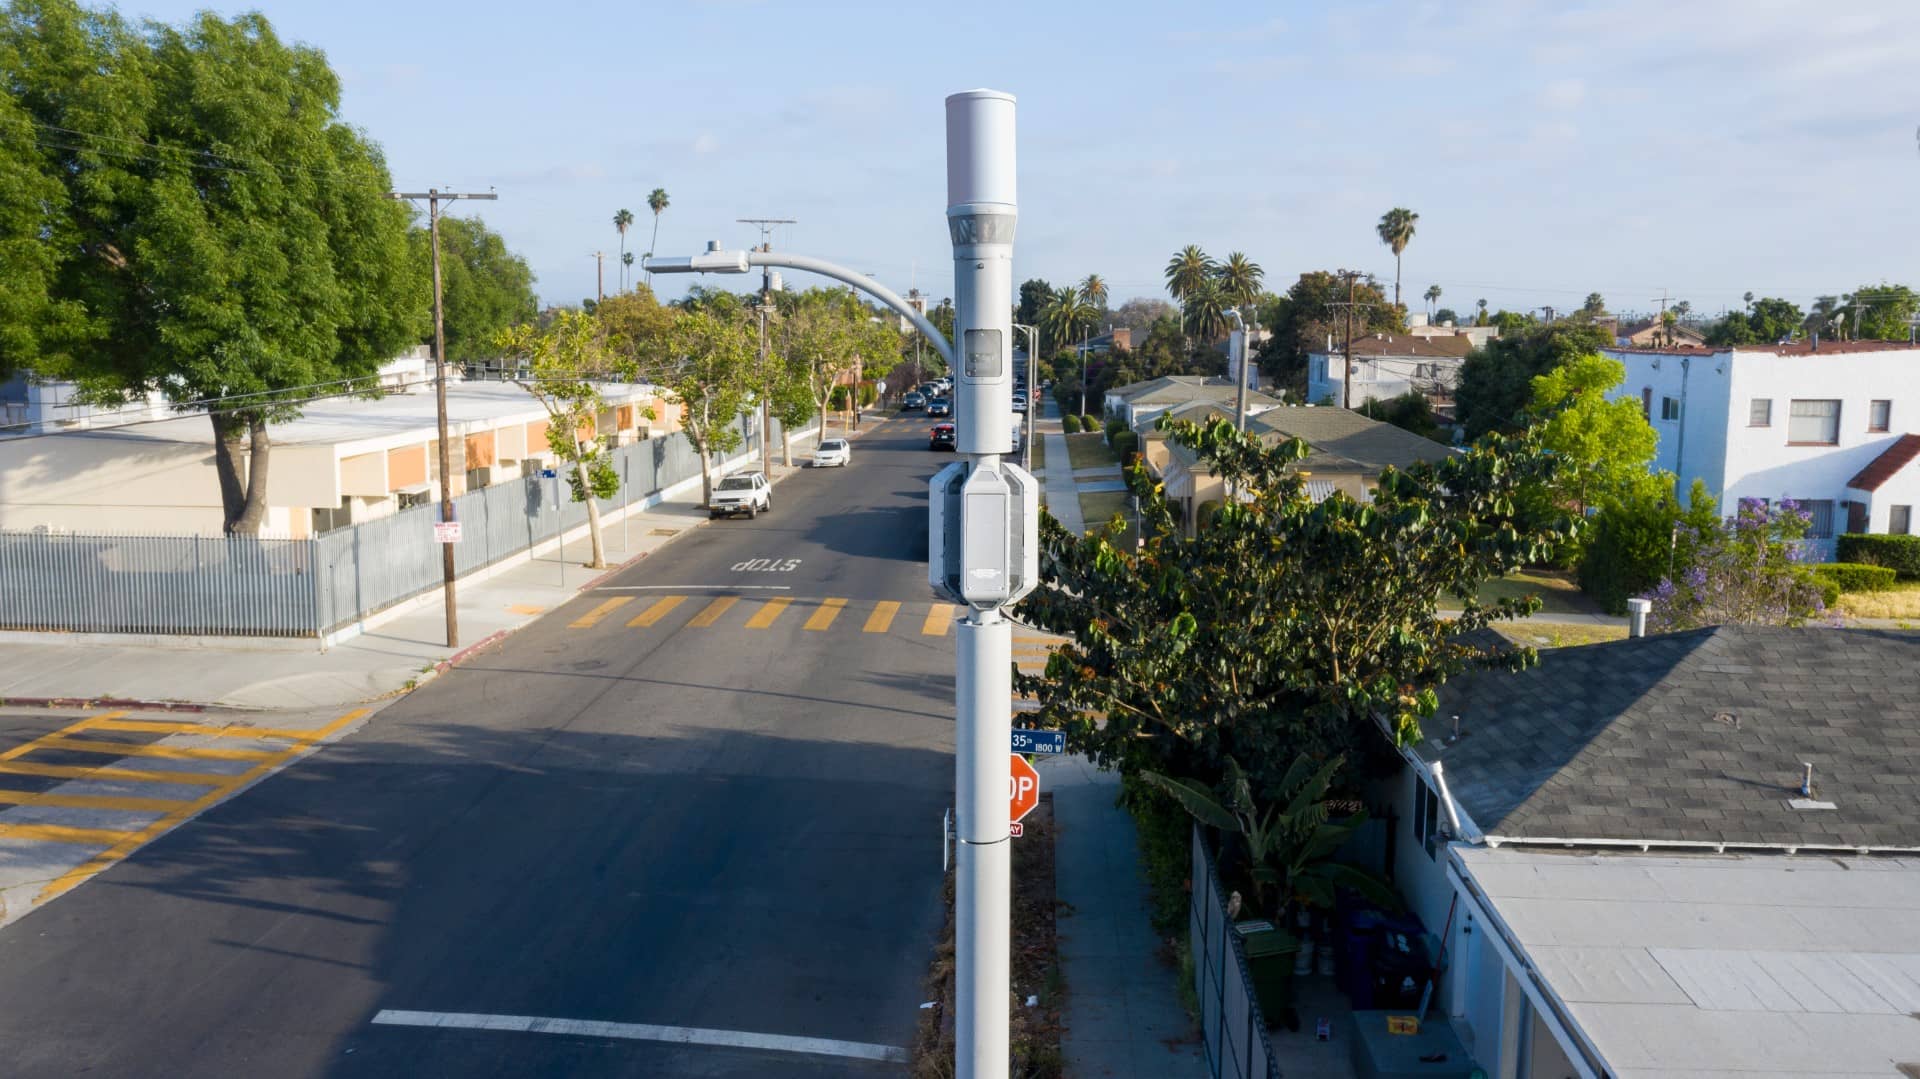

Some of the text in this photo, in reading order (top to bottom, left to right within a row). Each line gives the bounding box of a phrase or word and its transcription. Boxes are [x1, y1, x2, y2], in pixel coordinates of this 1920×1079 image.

[729, 558, 803, 572] STOP
[1035, 743, 1062, 752] 1800 W
